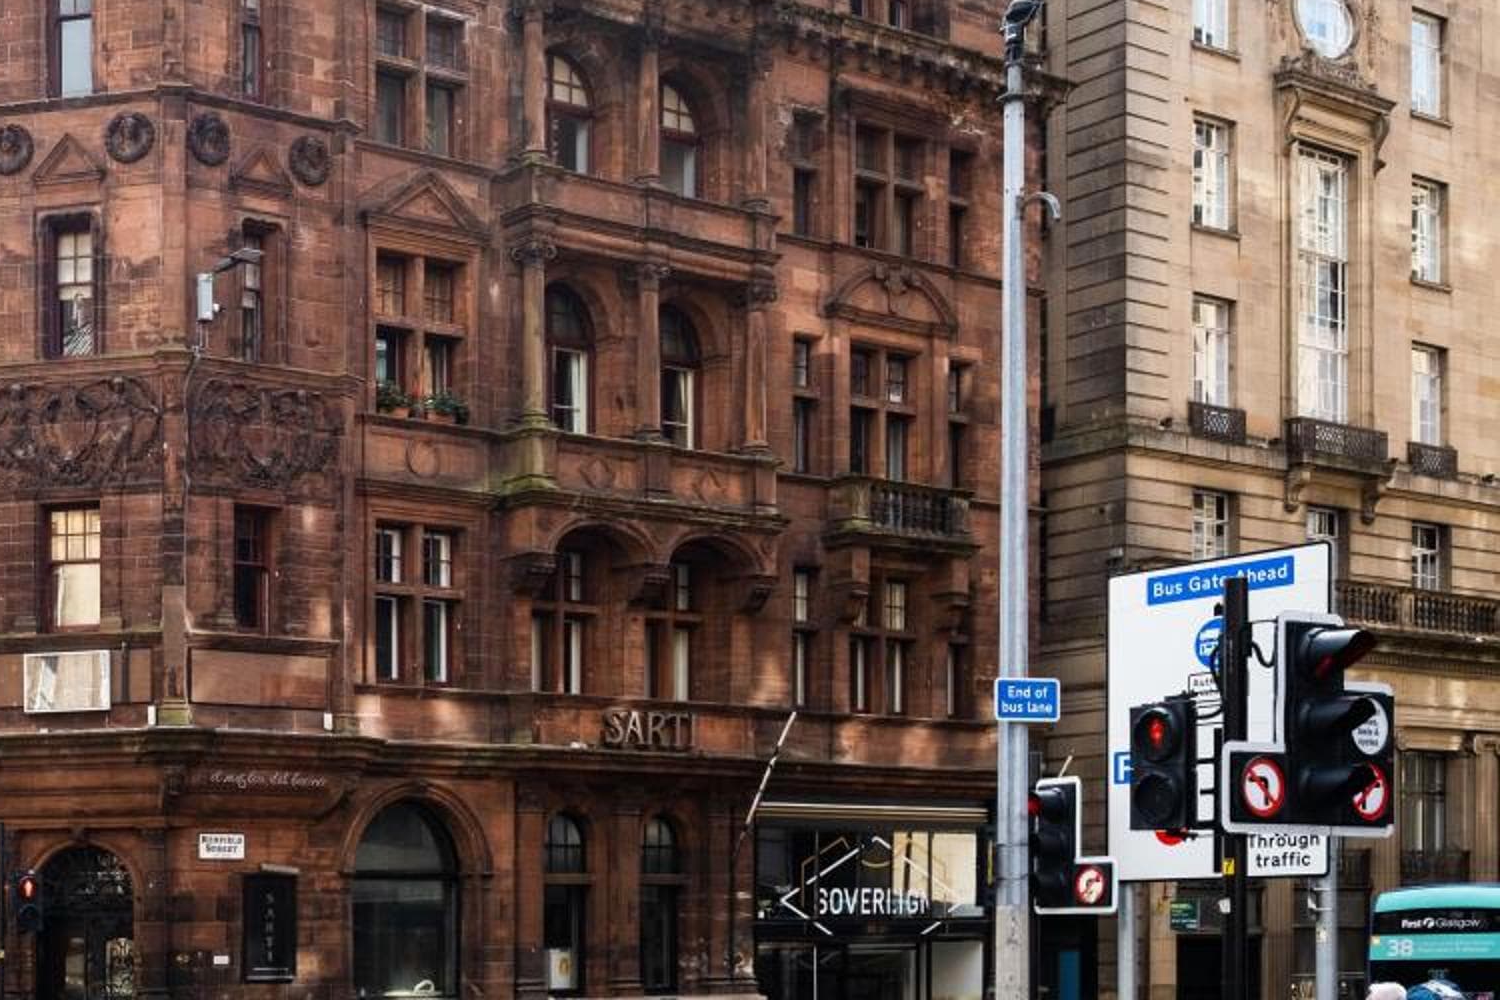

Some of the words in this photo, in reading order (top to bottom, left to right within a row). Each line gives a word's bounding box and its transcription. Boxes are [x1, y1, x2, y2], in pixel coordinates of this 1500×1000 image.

[1153, 582, 1184, 598] Bus
[1008, 685, 1031, 699] End
[1035, 685, 1048, 699] of
[1001, 700, 1023, 713] bus
[1027, 700, 1053, 713] lane
[604, 707, 697, 747] SARTI
[1249, 833, 1321, 849] Through
[1256, 851, 1311, 868] traffic
[1435, 918, 1480, 929] Glasgow
[1387, 939, 1413, 957] 38
